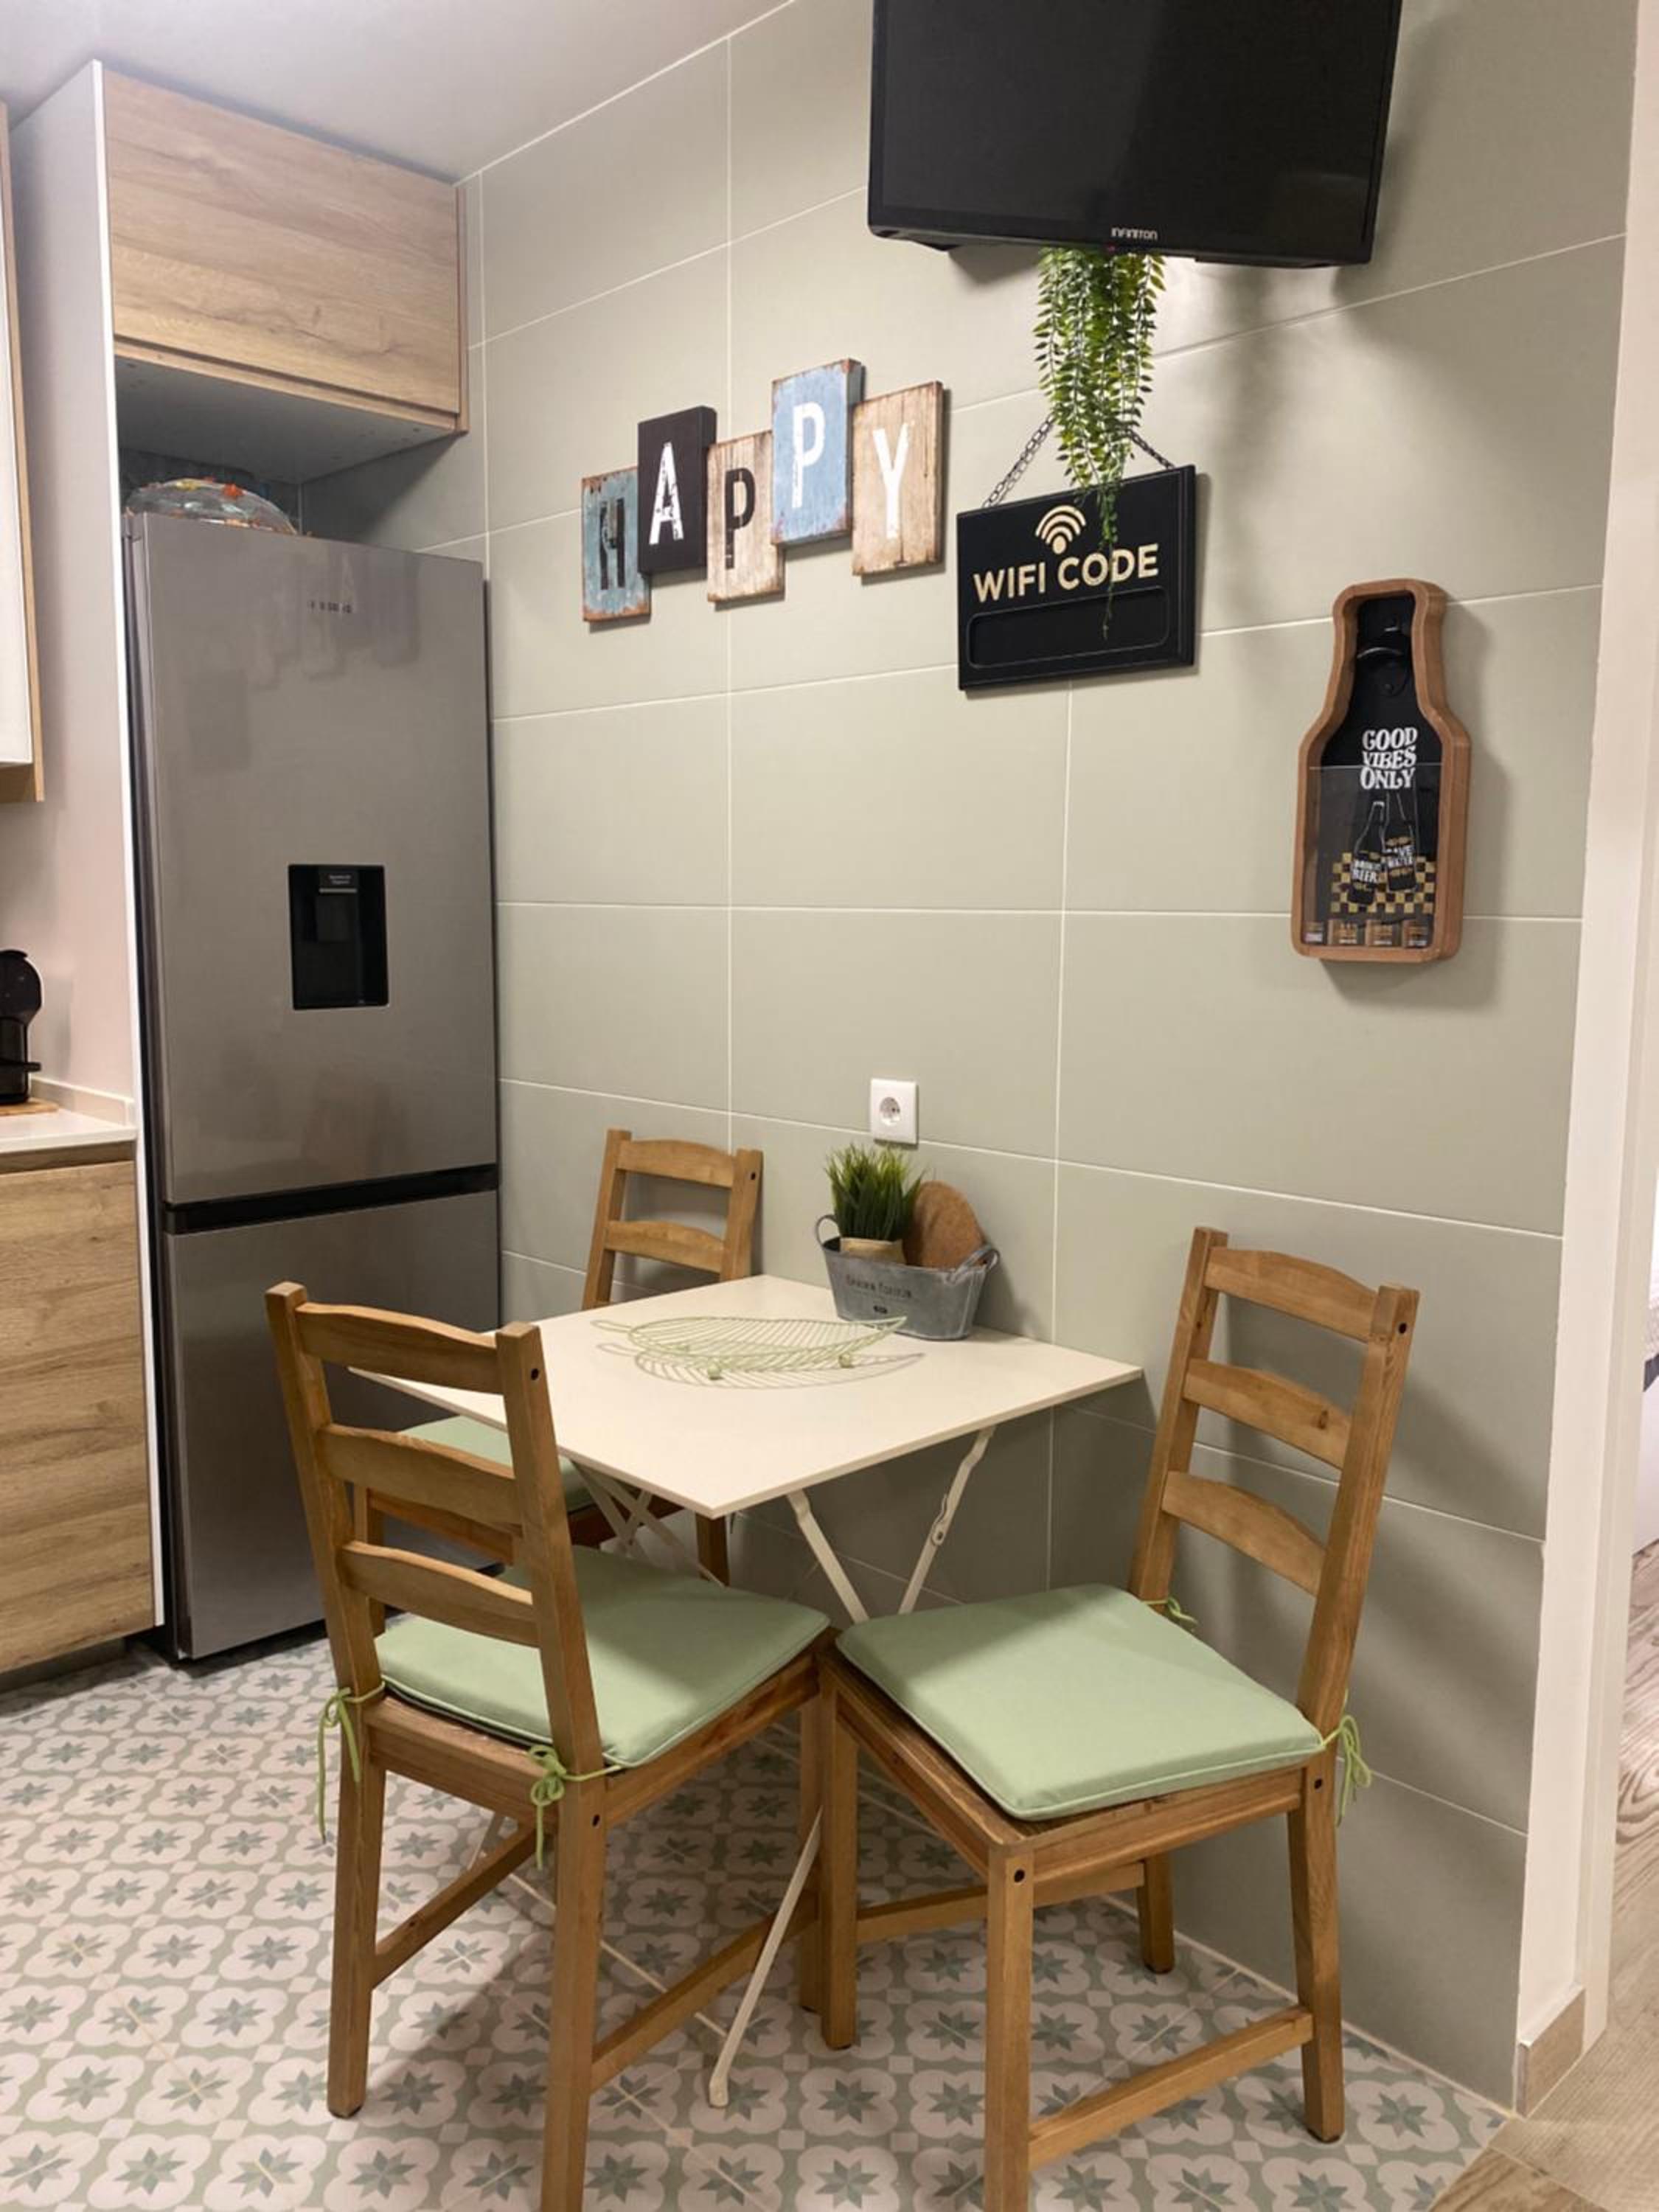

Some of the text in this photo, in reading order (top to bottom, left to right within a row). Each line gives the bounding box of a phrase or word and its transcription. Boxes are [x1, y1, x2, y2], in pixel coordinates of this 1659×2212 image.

[599, 400, 912, 591] HAPPY
[973, 543, 1159, 602] WIFI CODE
[1362, 726, 1418, 751] GOOD
[1362, 745, 1417, 770] VIBES
[1360, 766, 1416, 790] ONLY
